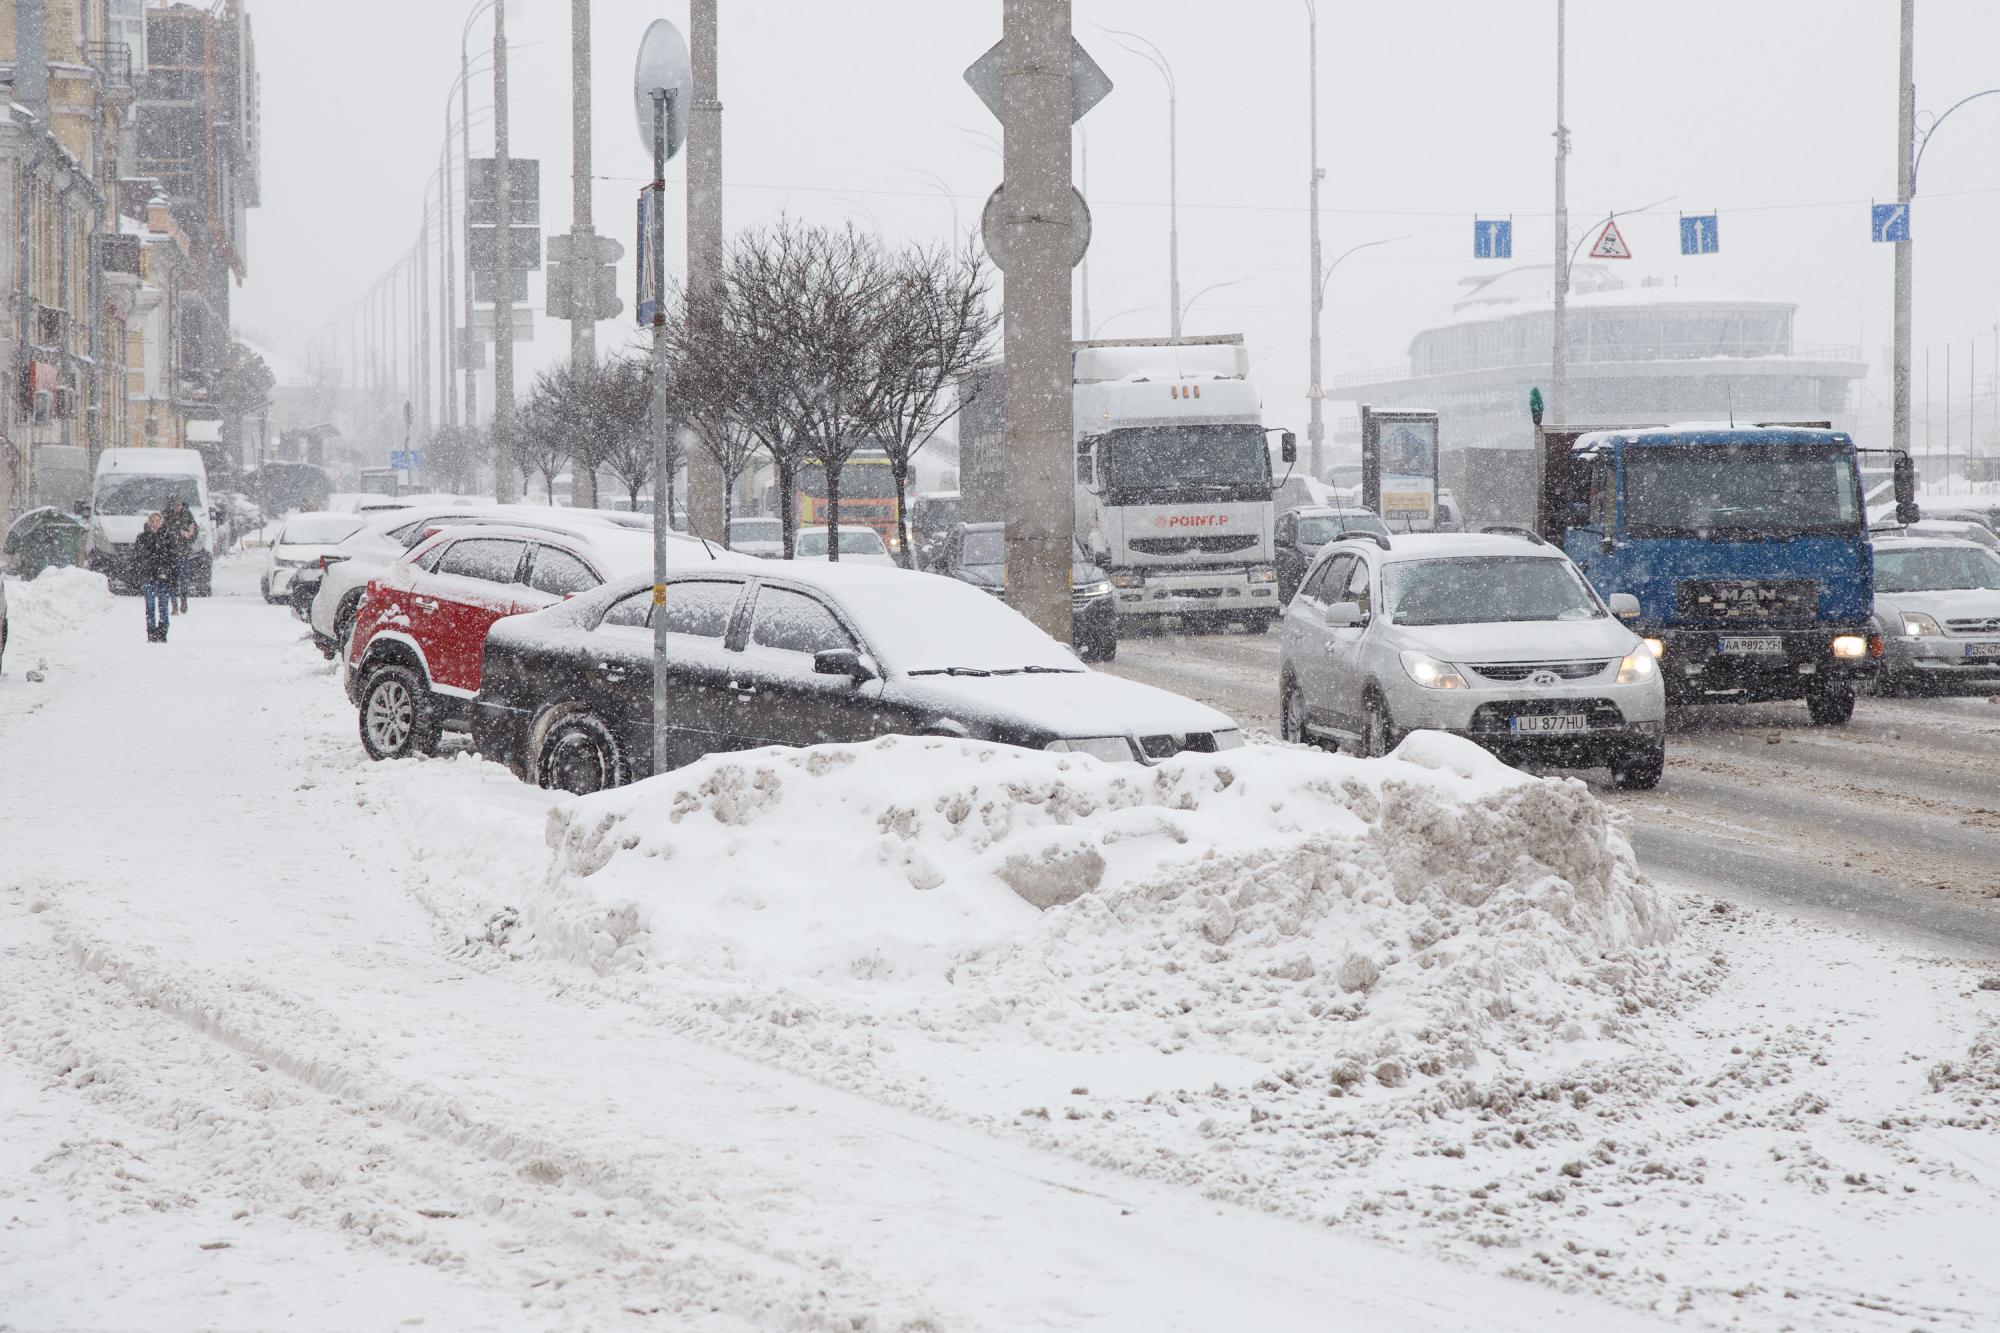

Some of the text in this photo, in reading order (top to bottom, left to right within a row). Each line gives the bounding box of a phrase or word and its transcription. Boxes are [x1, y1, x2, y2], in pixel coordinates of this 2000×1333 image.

[1169, 514, 1228, 527] POINT.P
[1721, 588, 1776, 602] MAN
[1725, 640, 1740, 651] AA
[1987, 645, 2000, 655] 47
[1519, 716, 1584, 731] LU 877HU
